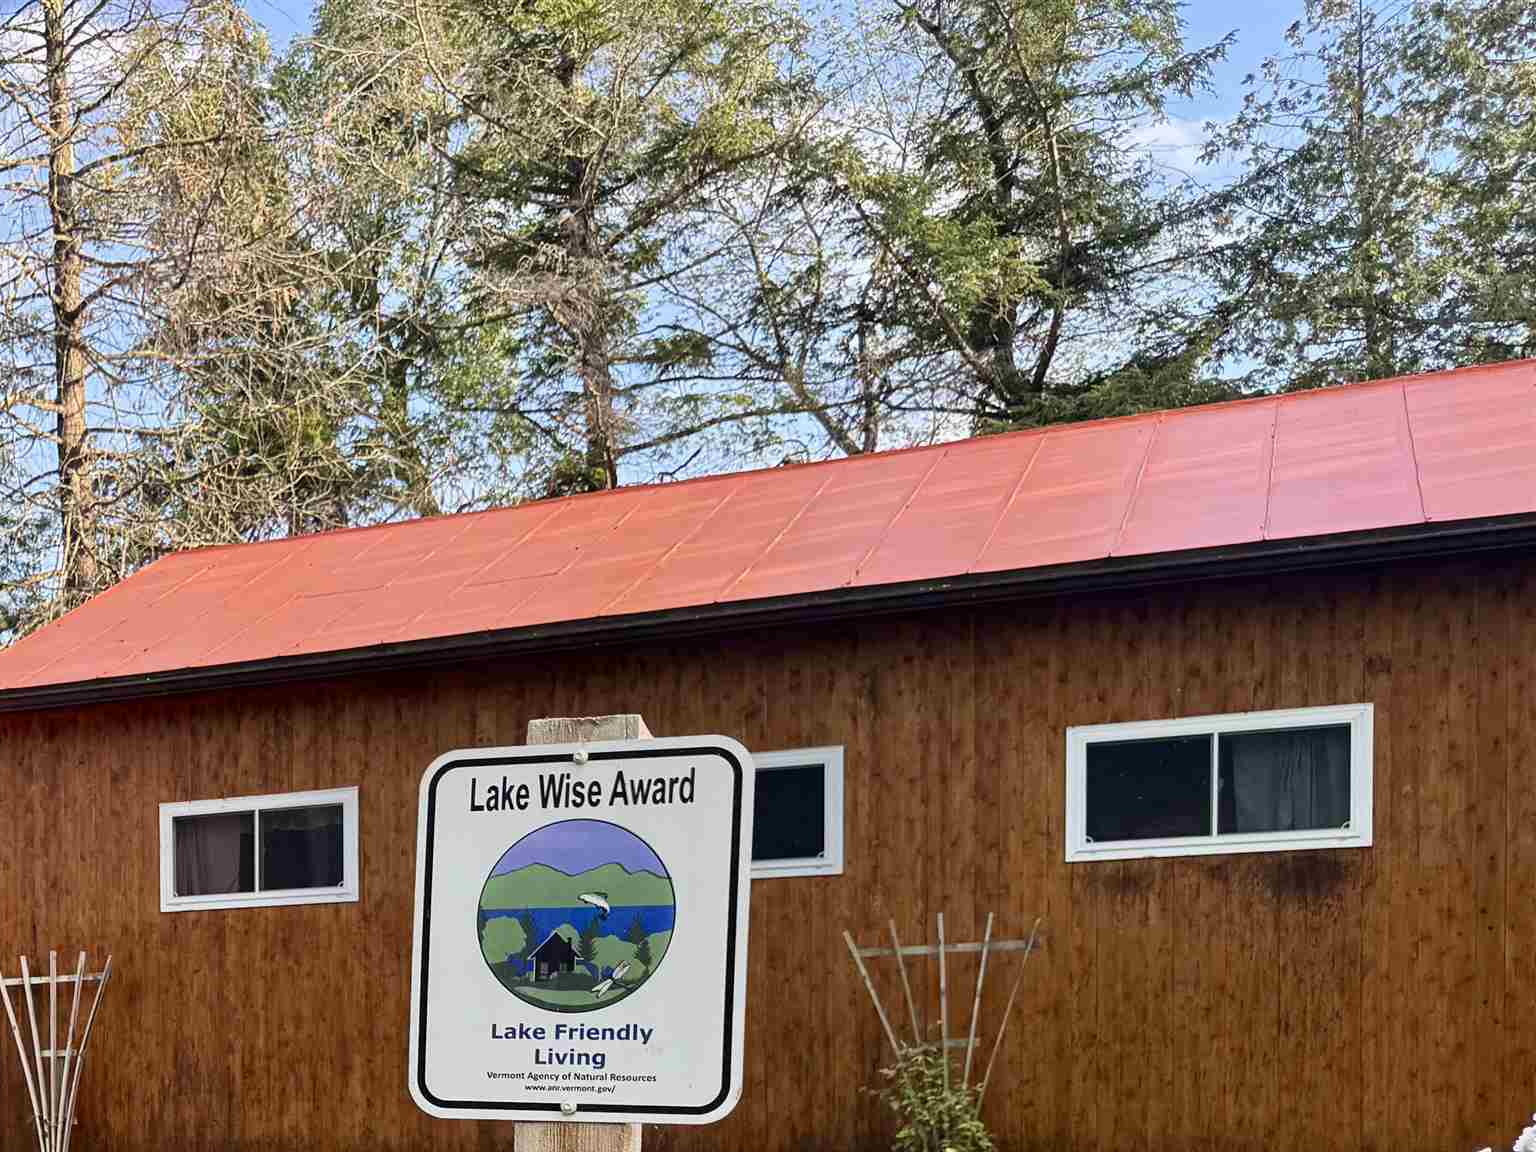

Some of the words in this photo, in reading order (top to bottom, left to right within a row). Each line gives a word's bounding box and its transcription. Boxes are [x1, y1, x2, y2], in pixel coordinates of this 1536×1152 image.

[470, 776, 530, 811] Lake
[539, 773, 602, 808] Wise
[609, 767, 695, 806] Award
[491, 1023, 546, 1040] Lake
[555, 1023, 654, 1045] Friendly
[534, 1048, 606, 1070] Living
[486, 1071, 525, 1080] Vermont
[527, 1071, 560, 1083] Agency
[561, 1071, 572, 1081] of
[573, 1072, 608, 1082] Natural
[609, 1073, 657, 1083] Resources
